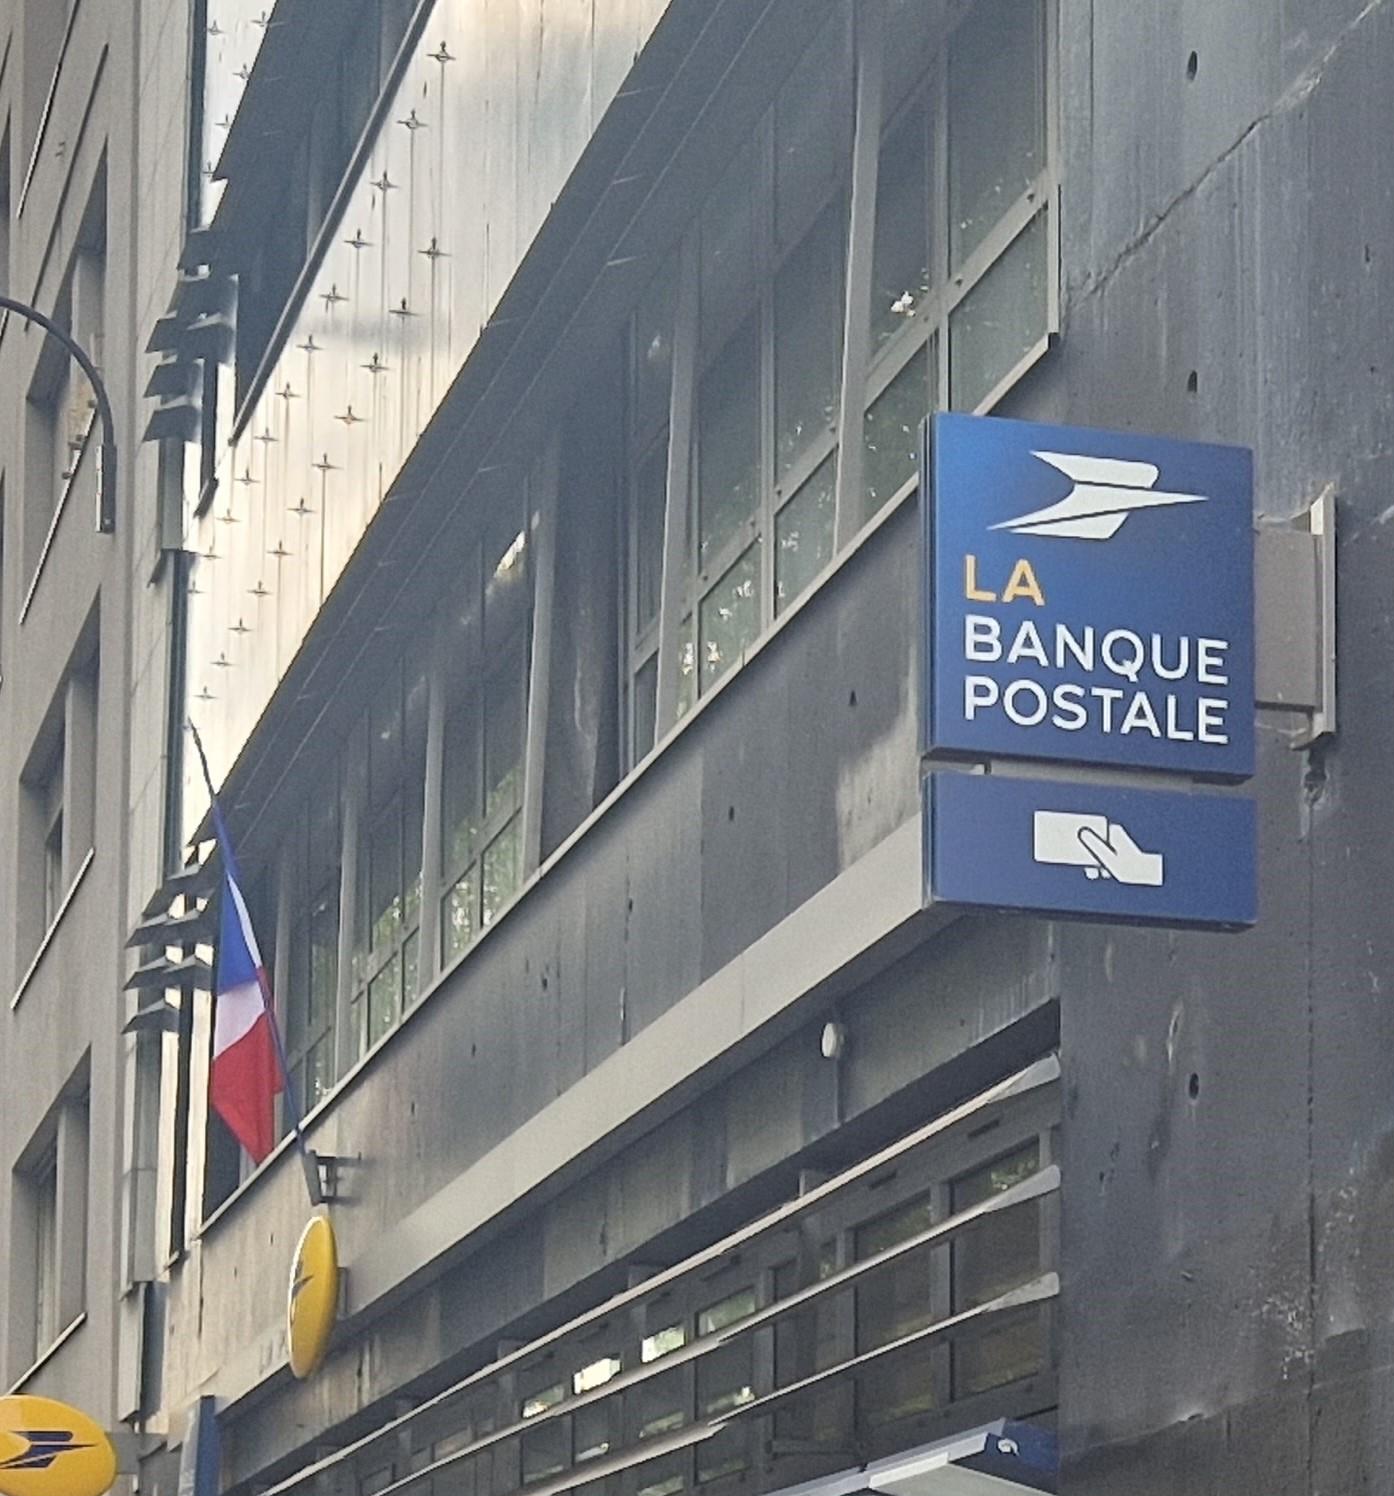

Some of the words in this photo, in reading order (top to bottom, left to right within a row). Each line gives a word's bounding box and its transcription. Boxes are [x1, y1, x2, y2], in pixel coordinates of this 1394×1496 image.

[964, 555, 1045, 606] LA
[964, 614, 1229, 685] BANQUE
[964, 675, 1229, 745] POSTALE
